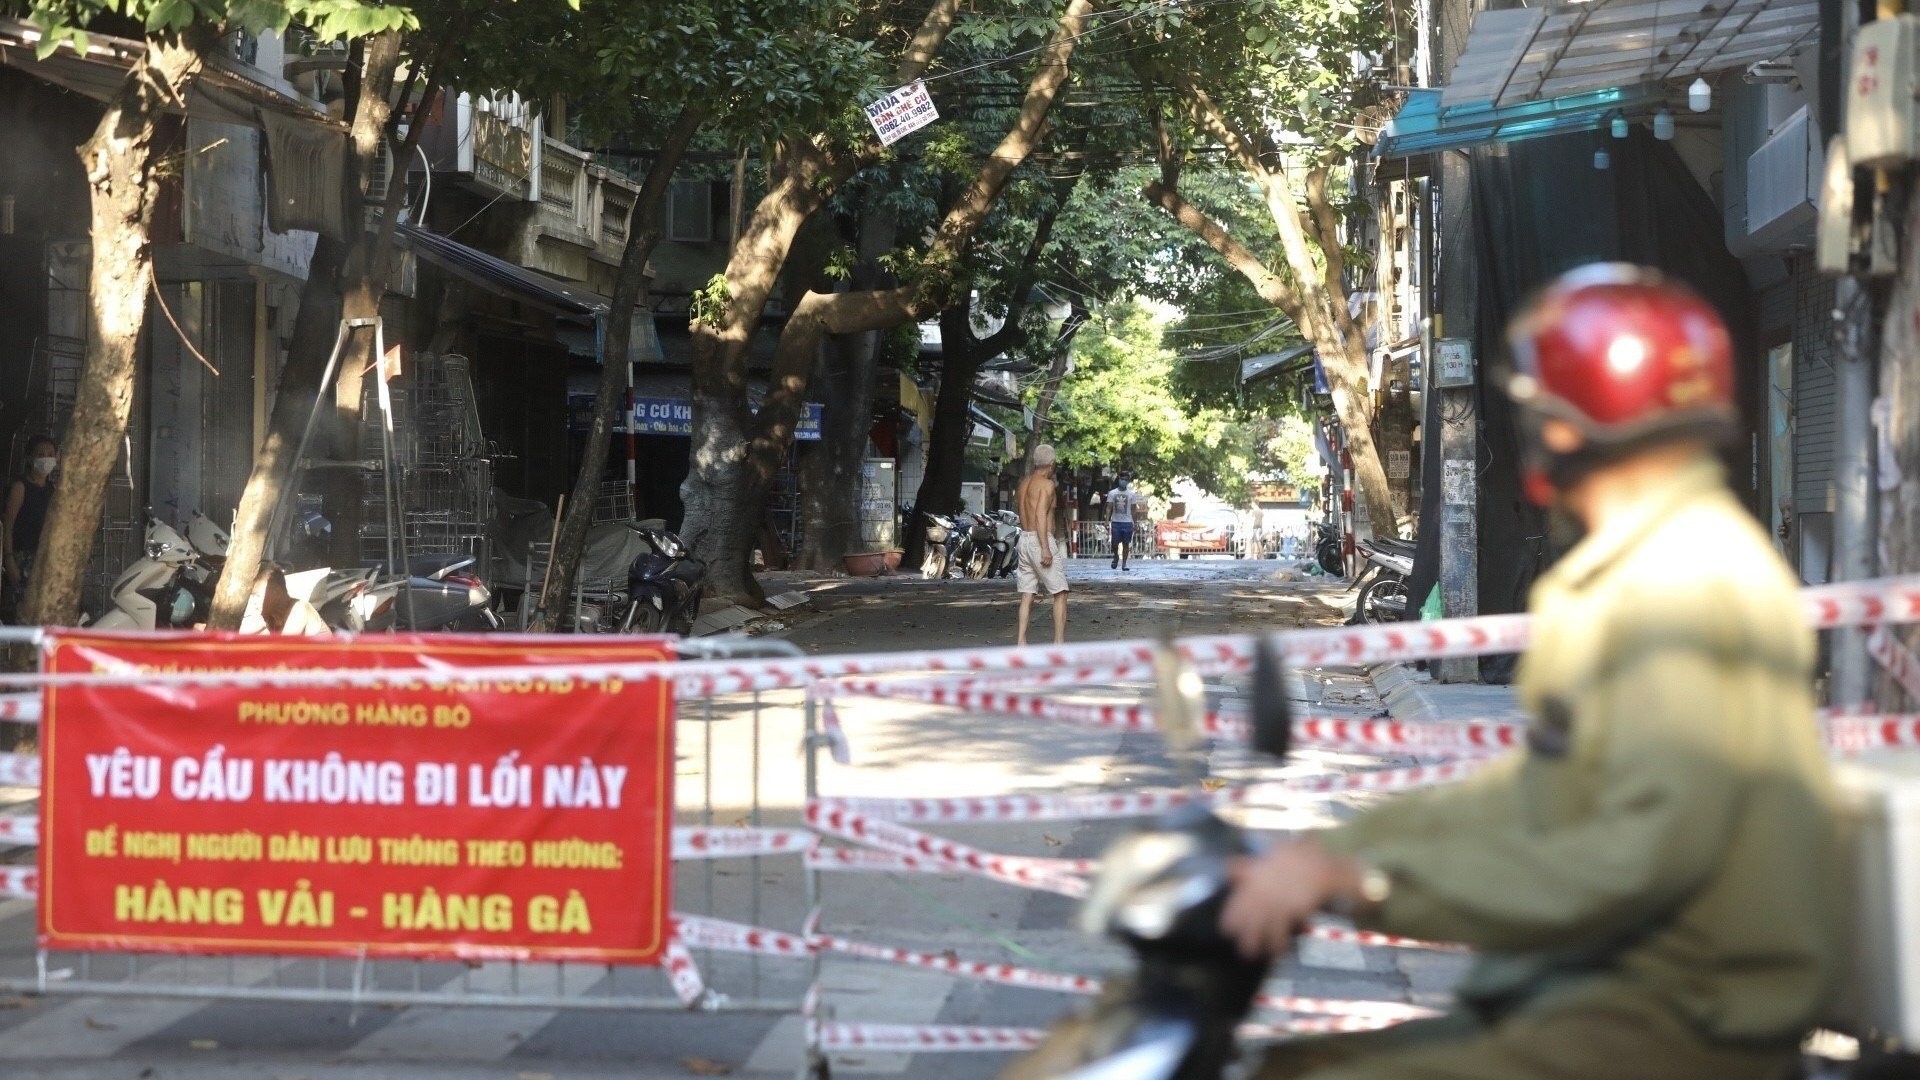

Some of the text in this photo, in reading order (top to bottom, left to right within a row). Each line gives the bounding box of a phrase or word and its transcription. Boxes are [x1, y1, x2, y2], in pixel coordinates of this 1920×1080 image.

[868, 95, 900, 117] MUA
[879, 101, 932, 135] 0962.40.9982
[650, 403, 670, 419] CƠ
[356, 699, 428, 727] HÀNG
[86, 746, 161, 798] YÊU
[264, 752, 404, 804] KHÔNG
[414, 761, 458, 806] ĐI
[469, 750, 532, 808] LỐI
[543, 756, 627, 809] NÀY
[123, 831, 181, 864] NGHỊ
[187, 829, 262, 861] NGƯỜI
[269, 831, 320, 863] DÂN
[379, 833, 459, 867] THÔNG
[466, 839, 526, 868] THEO
[115, 878, 244, 925] HÀNG
[257, 878, 335, 928] VẢI
[382, 885, 513, 931] HÀNG
[527, 888, 592, 935] GÀ
